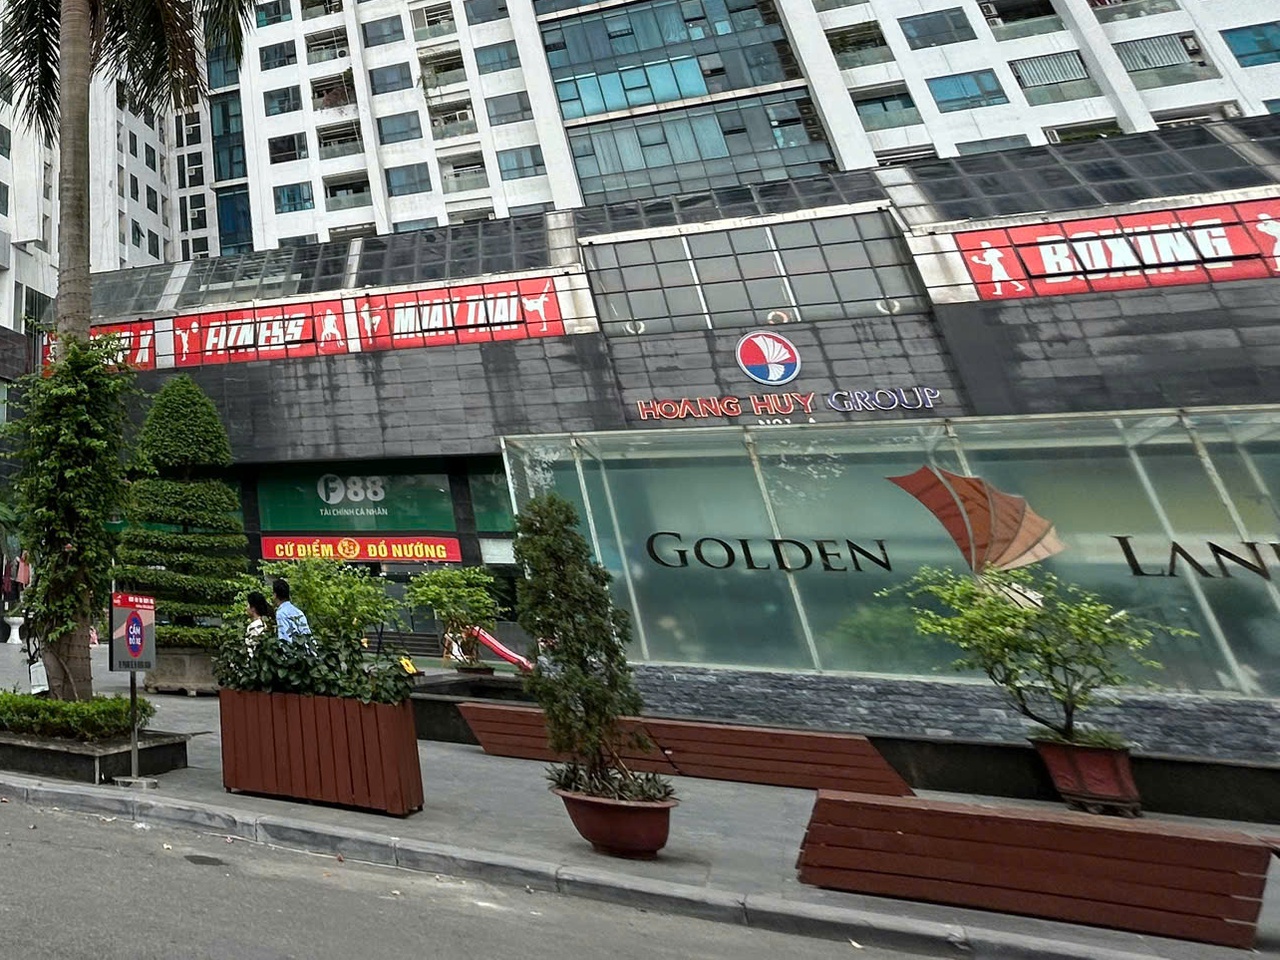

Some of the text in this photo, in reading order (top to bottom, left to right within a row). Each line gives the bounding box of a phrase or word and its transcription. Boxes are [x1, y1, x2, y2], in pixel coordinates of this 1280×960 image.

[1036, 218, 1233, 284] BOXING
[393, 291, 519, 339] MUAY THAI
[205, 313, 307, 356] FITNESS
[636, 387, 941, 421] HOANG HUY GROUP
[319, 474, 385, 504] F88
[320, 507, 331, 516] TÀI
[332, 507, 354, 516] CHÍNH
[366, 506, 388, 516] NHÂN
[297, 539, 334, 557] ĐIỂM
[392, 541, 447, 558] NƯỚNG
[646, 531, 1280, 580] GOLDEN LAN
